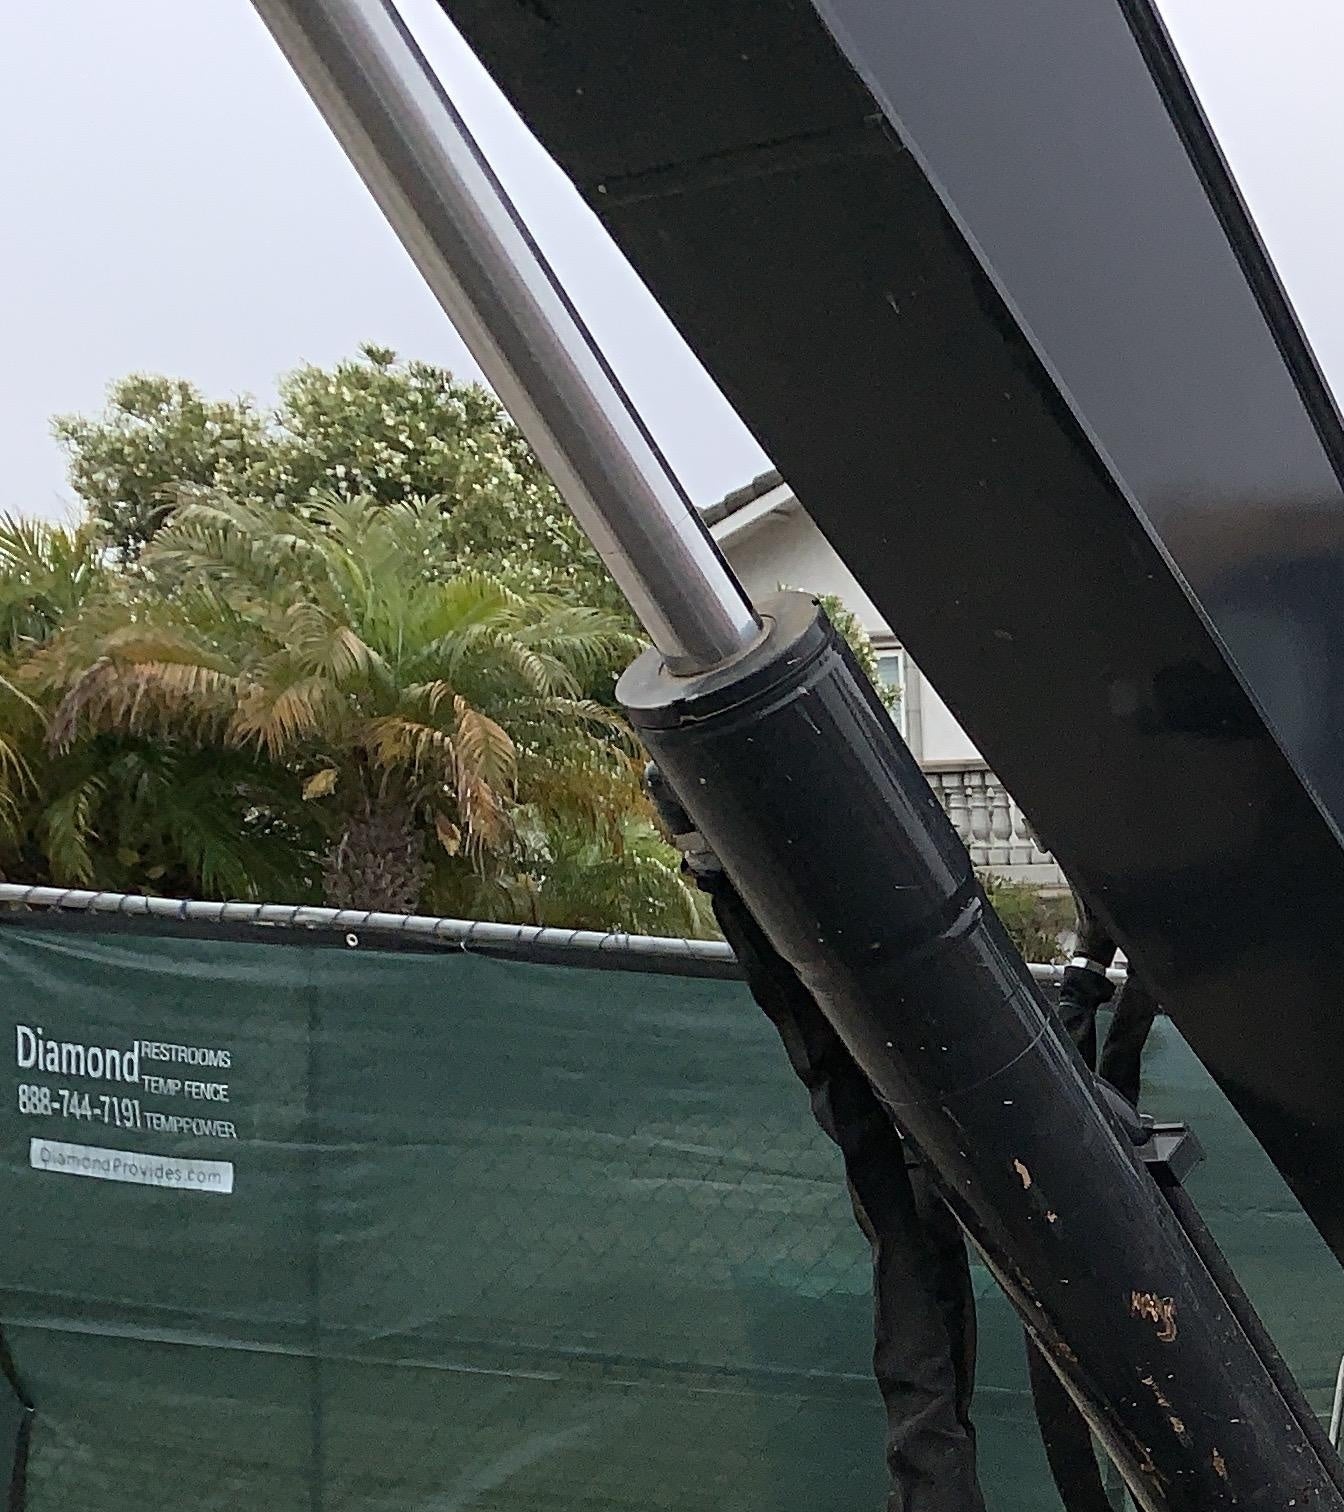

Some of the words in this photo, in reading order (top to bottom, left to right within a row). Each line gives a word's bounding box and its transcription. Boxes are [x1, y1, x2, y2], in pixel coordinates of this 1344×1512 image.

[16, 1024, 140, 1083] Diamond
[141, 1040, 231, 1068] RESTROOMS
[18, 1084, 142, 1129] 888-744-7191
[141, 1075, 182, 1097] TEMP
[184, 1080, 230, 1102] FENCE
[40, 1147, 222, 1184] DiamondProvides.com
